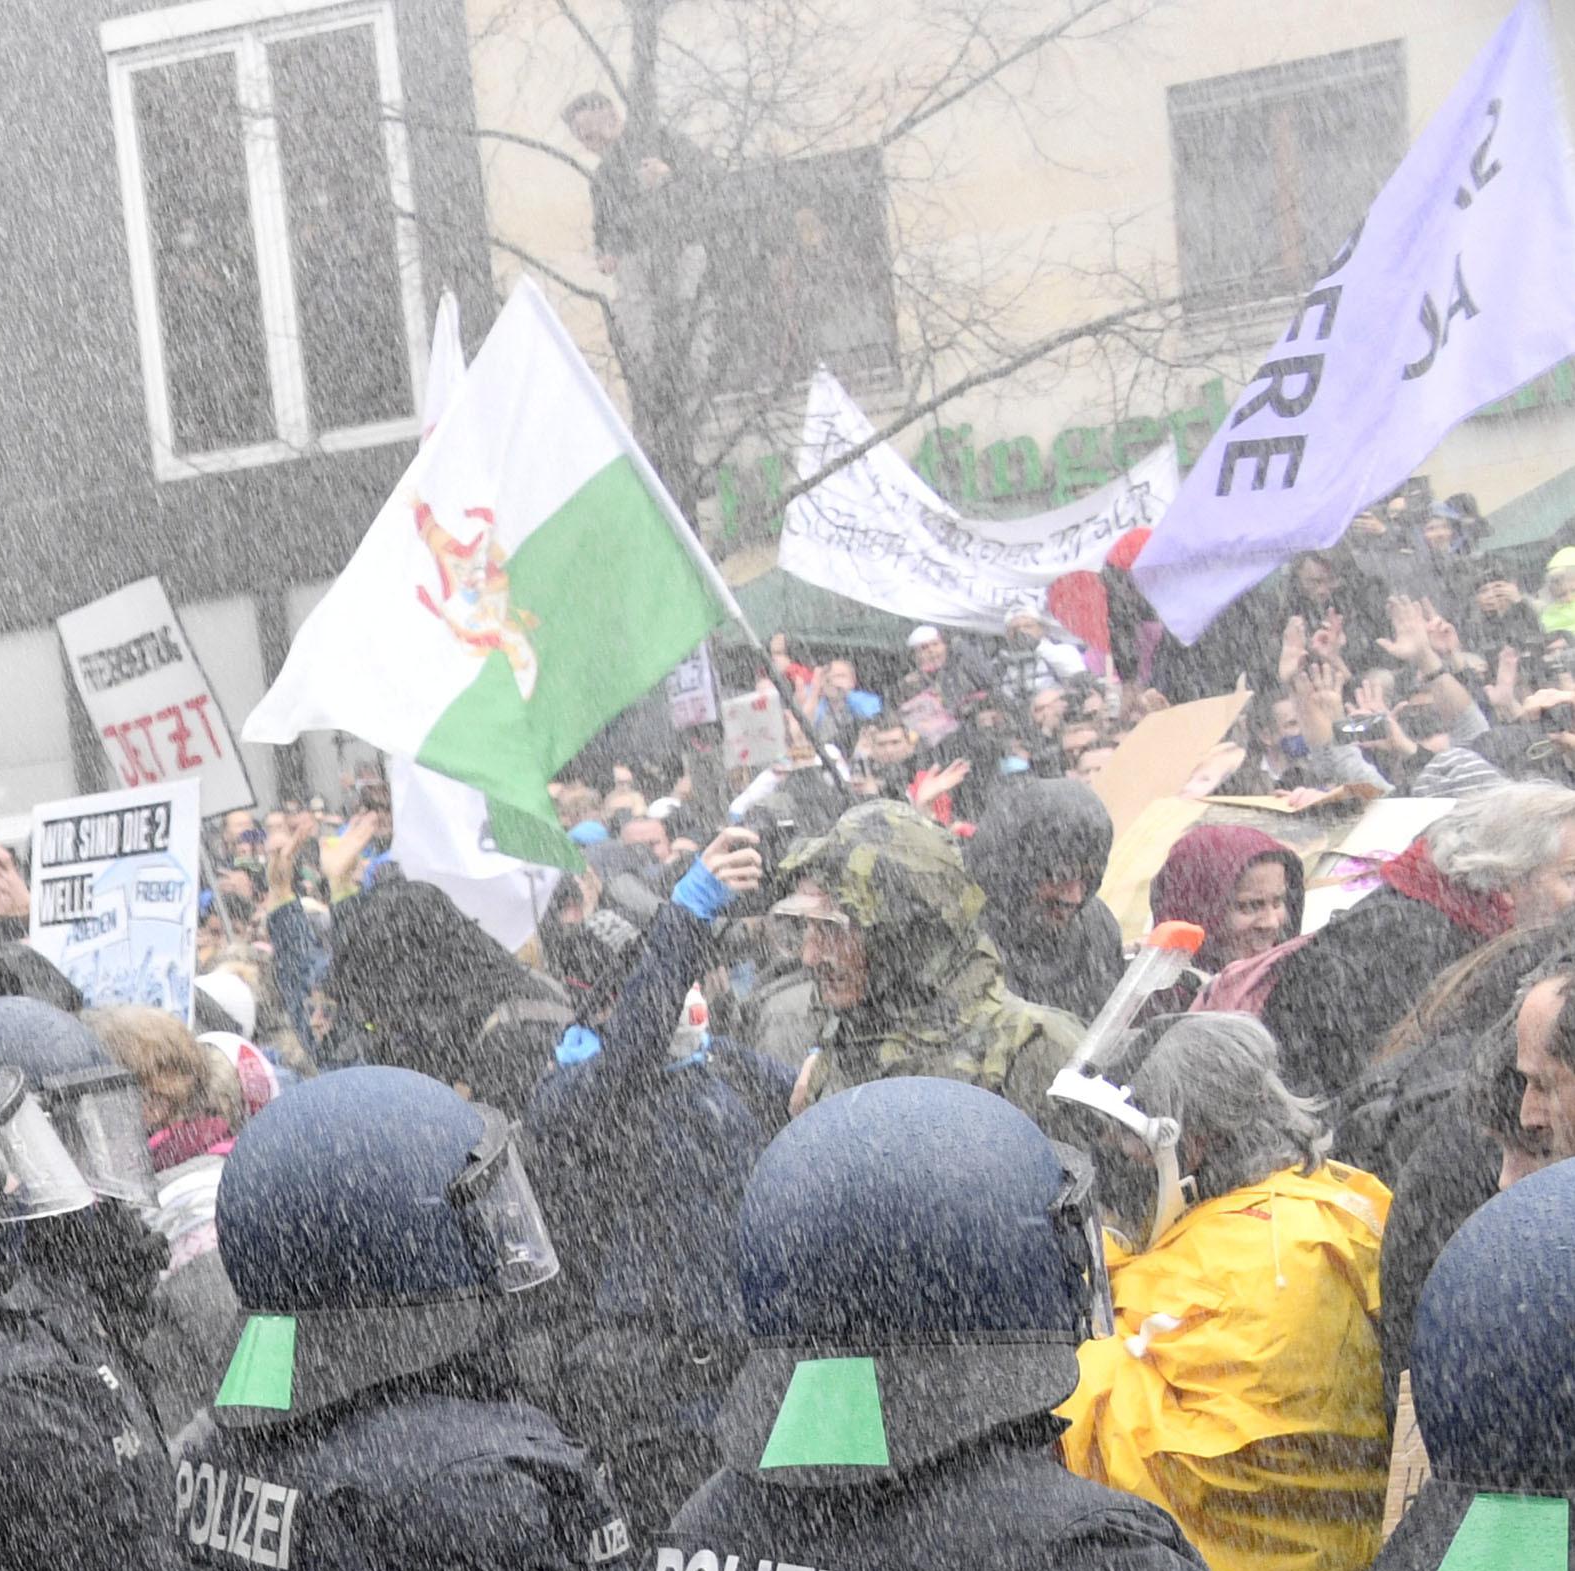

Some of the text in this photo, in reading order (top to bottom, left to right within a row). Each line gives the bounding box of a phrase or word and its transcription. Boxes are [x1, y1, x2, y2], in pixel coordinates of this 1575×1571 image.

[103, 694, 222, 788] JETZT
[42, 820, 77, 865] WIR
[78, 813, 120, 860] SIND
[122, 806, 152, 854] DIE
[40, 875, 95, 925] WELLE
[175, 1460, 299, 1570] POLIZEI
